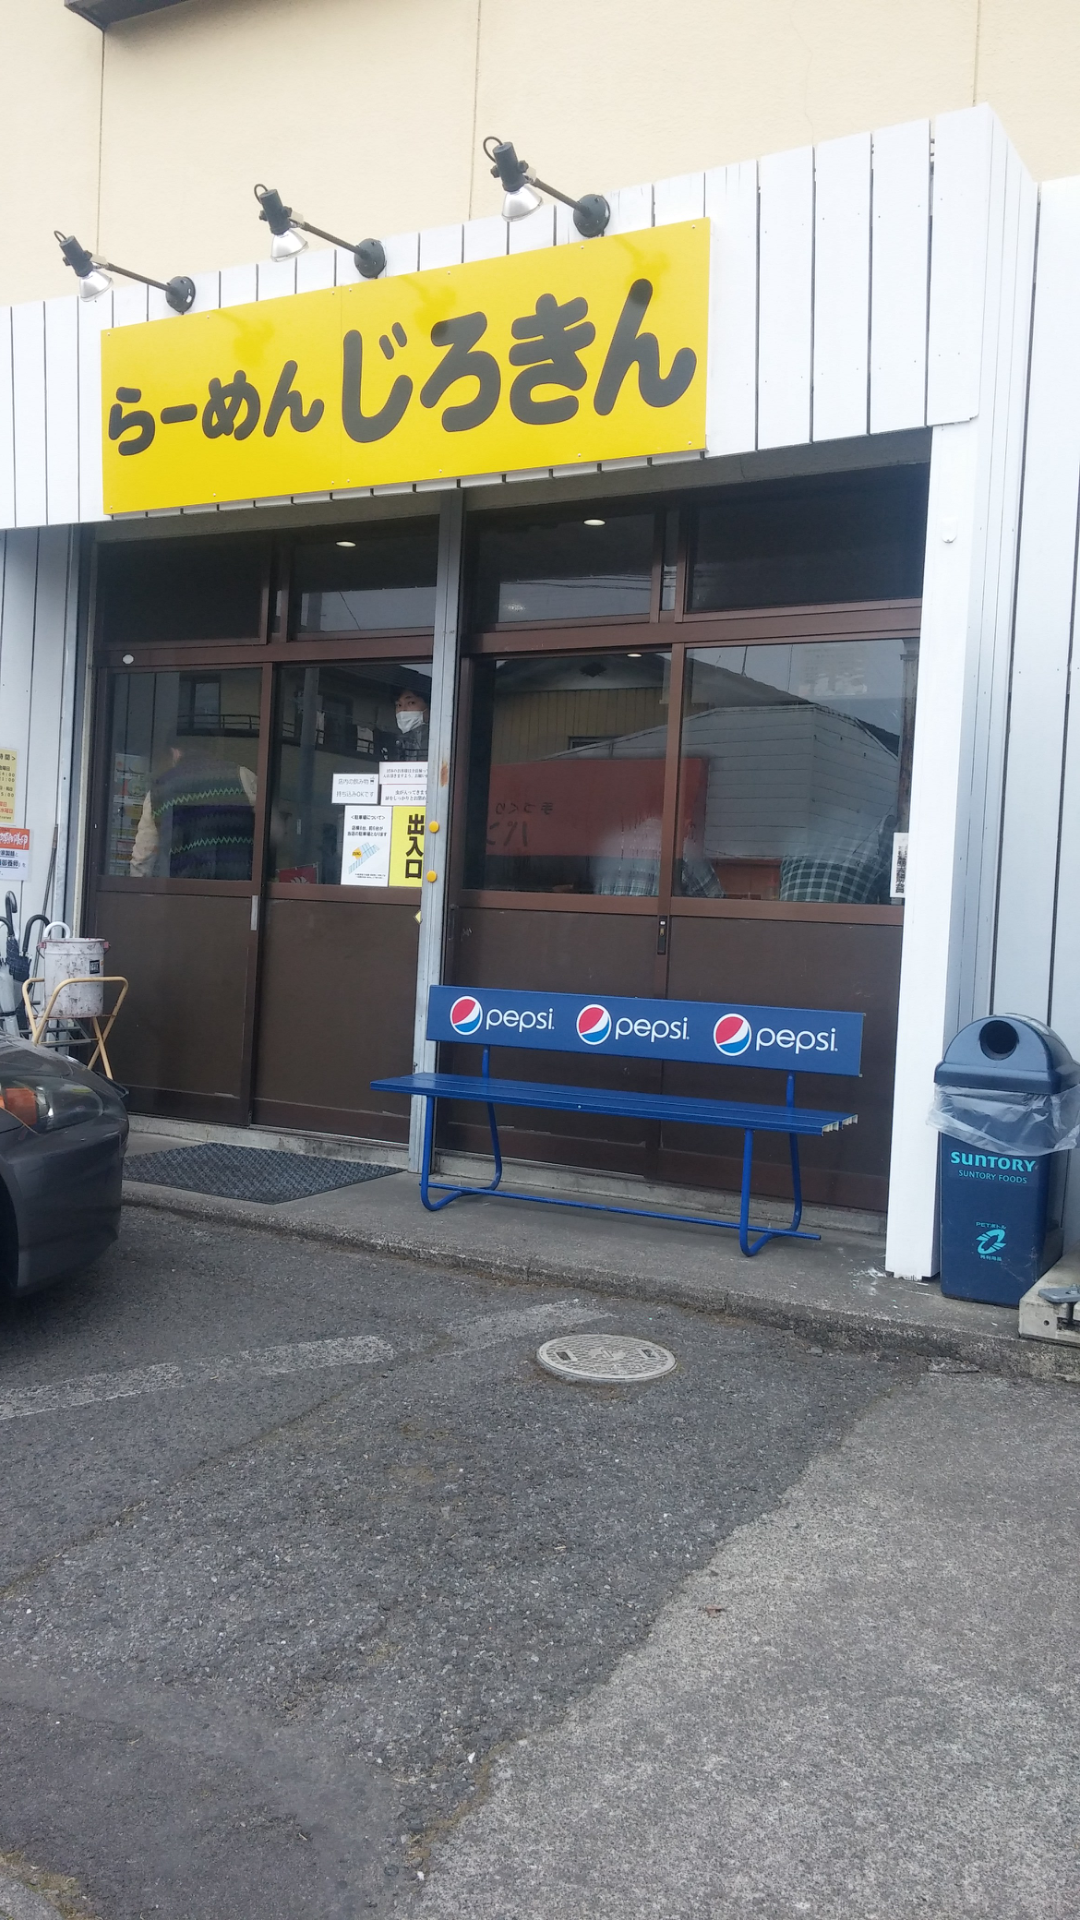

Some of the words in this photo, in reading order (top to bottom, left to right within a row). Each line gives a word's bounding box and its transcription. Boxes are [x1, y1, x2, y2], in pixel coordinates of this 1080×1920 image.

[109, 360, 324, 456] らーめん
[342, 278, 697, 443] じろきん
[405, 814, 424, 879] 出入口
[486, 1007, 553, 1033] pepsi
[615, 1016, 688, 1043] pepsi
[755, 1026, 836, 1054] pepsi
[950, 1151, 1036, 1172] SUNTORY
[958, 1169, 996, 1181] SUNTORY
[998, 1174, 1028, 1184] FOODS
